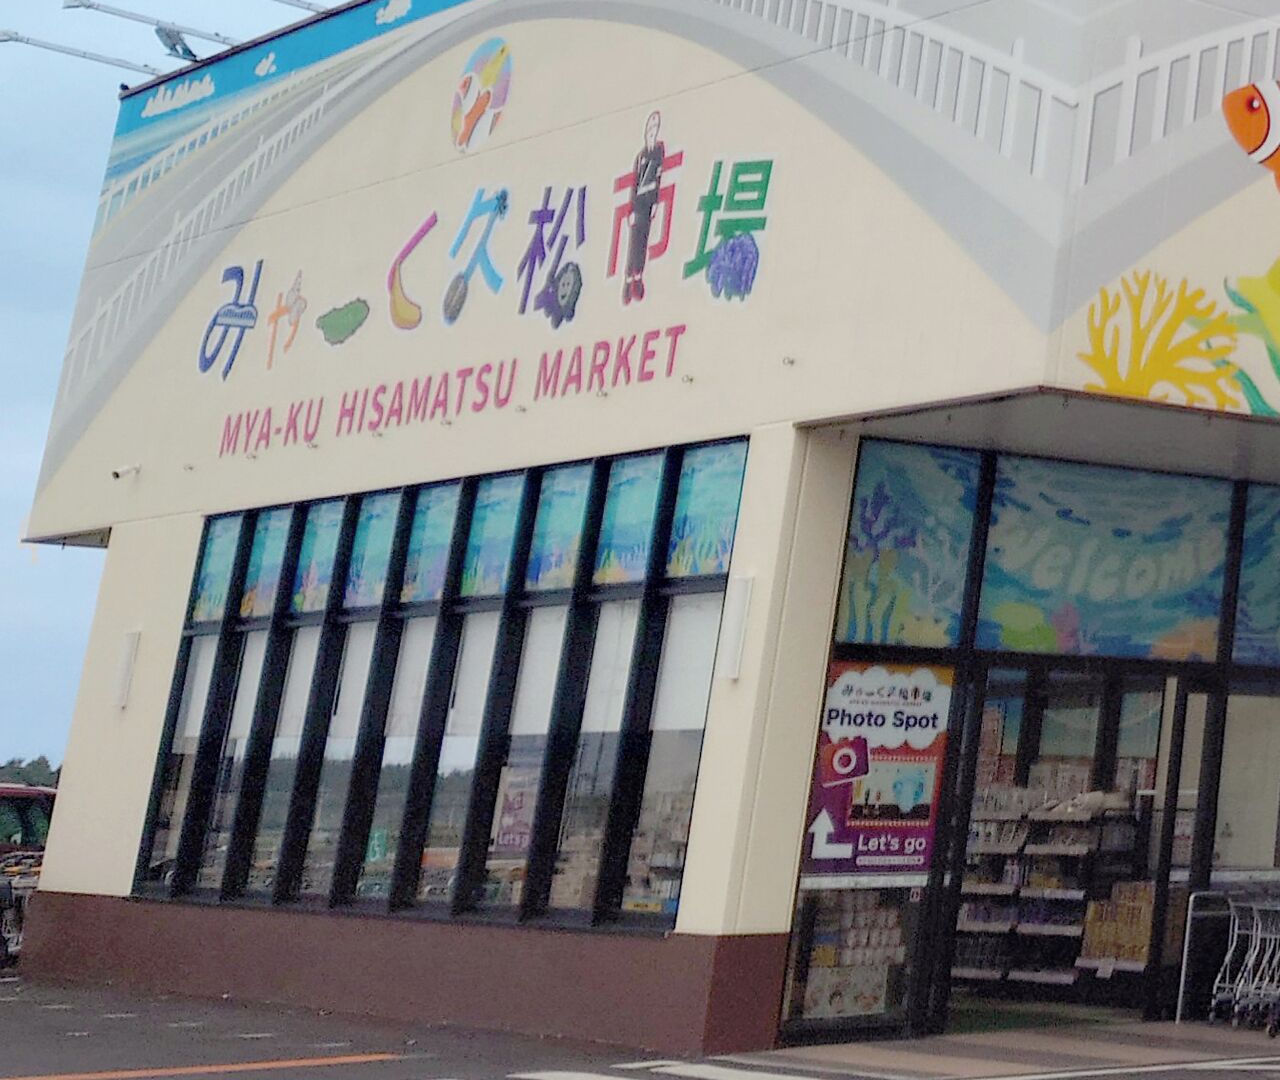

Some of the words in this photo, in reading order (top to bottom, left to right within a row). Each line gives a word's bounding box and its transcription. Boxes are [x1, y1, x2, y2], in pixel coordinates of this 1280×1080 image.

[219, 397, 325, 458] MYA-KU
[335, 358, 519, 437] HISAMATSU
[533, 323, 688, 404] MARKET
[827, 708, 887, 728] Photo
[892, 710, 939, 731] Spot
[857, 833, 899, 852] Let's
[904, 836, 927, 855] go
